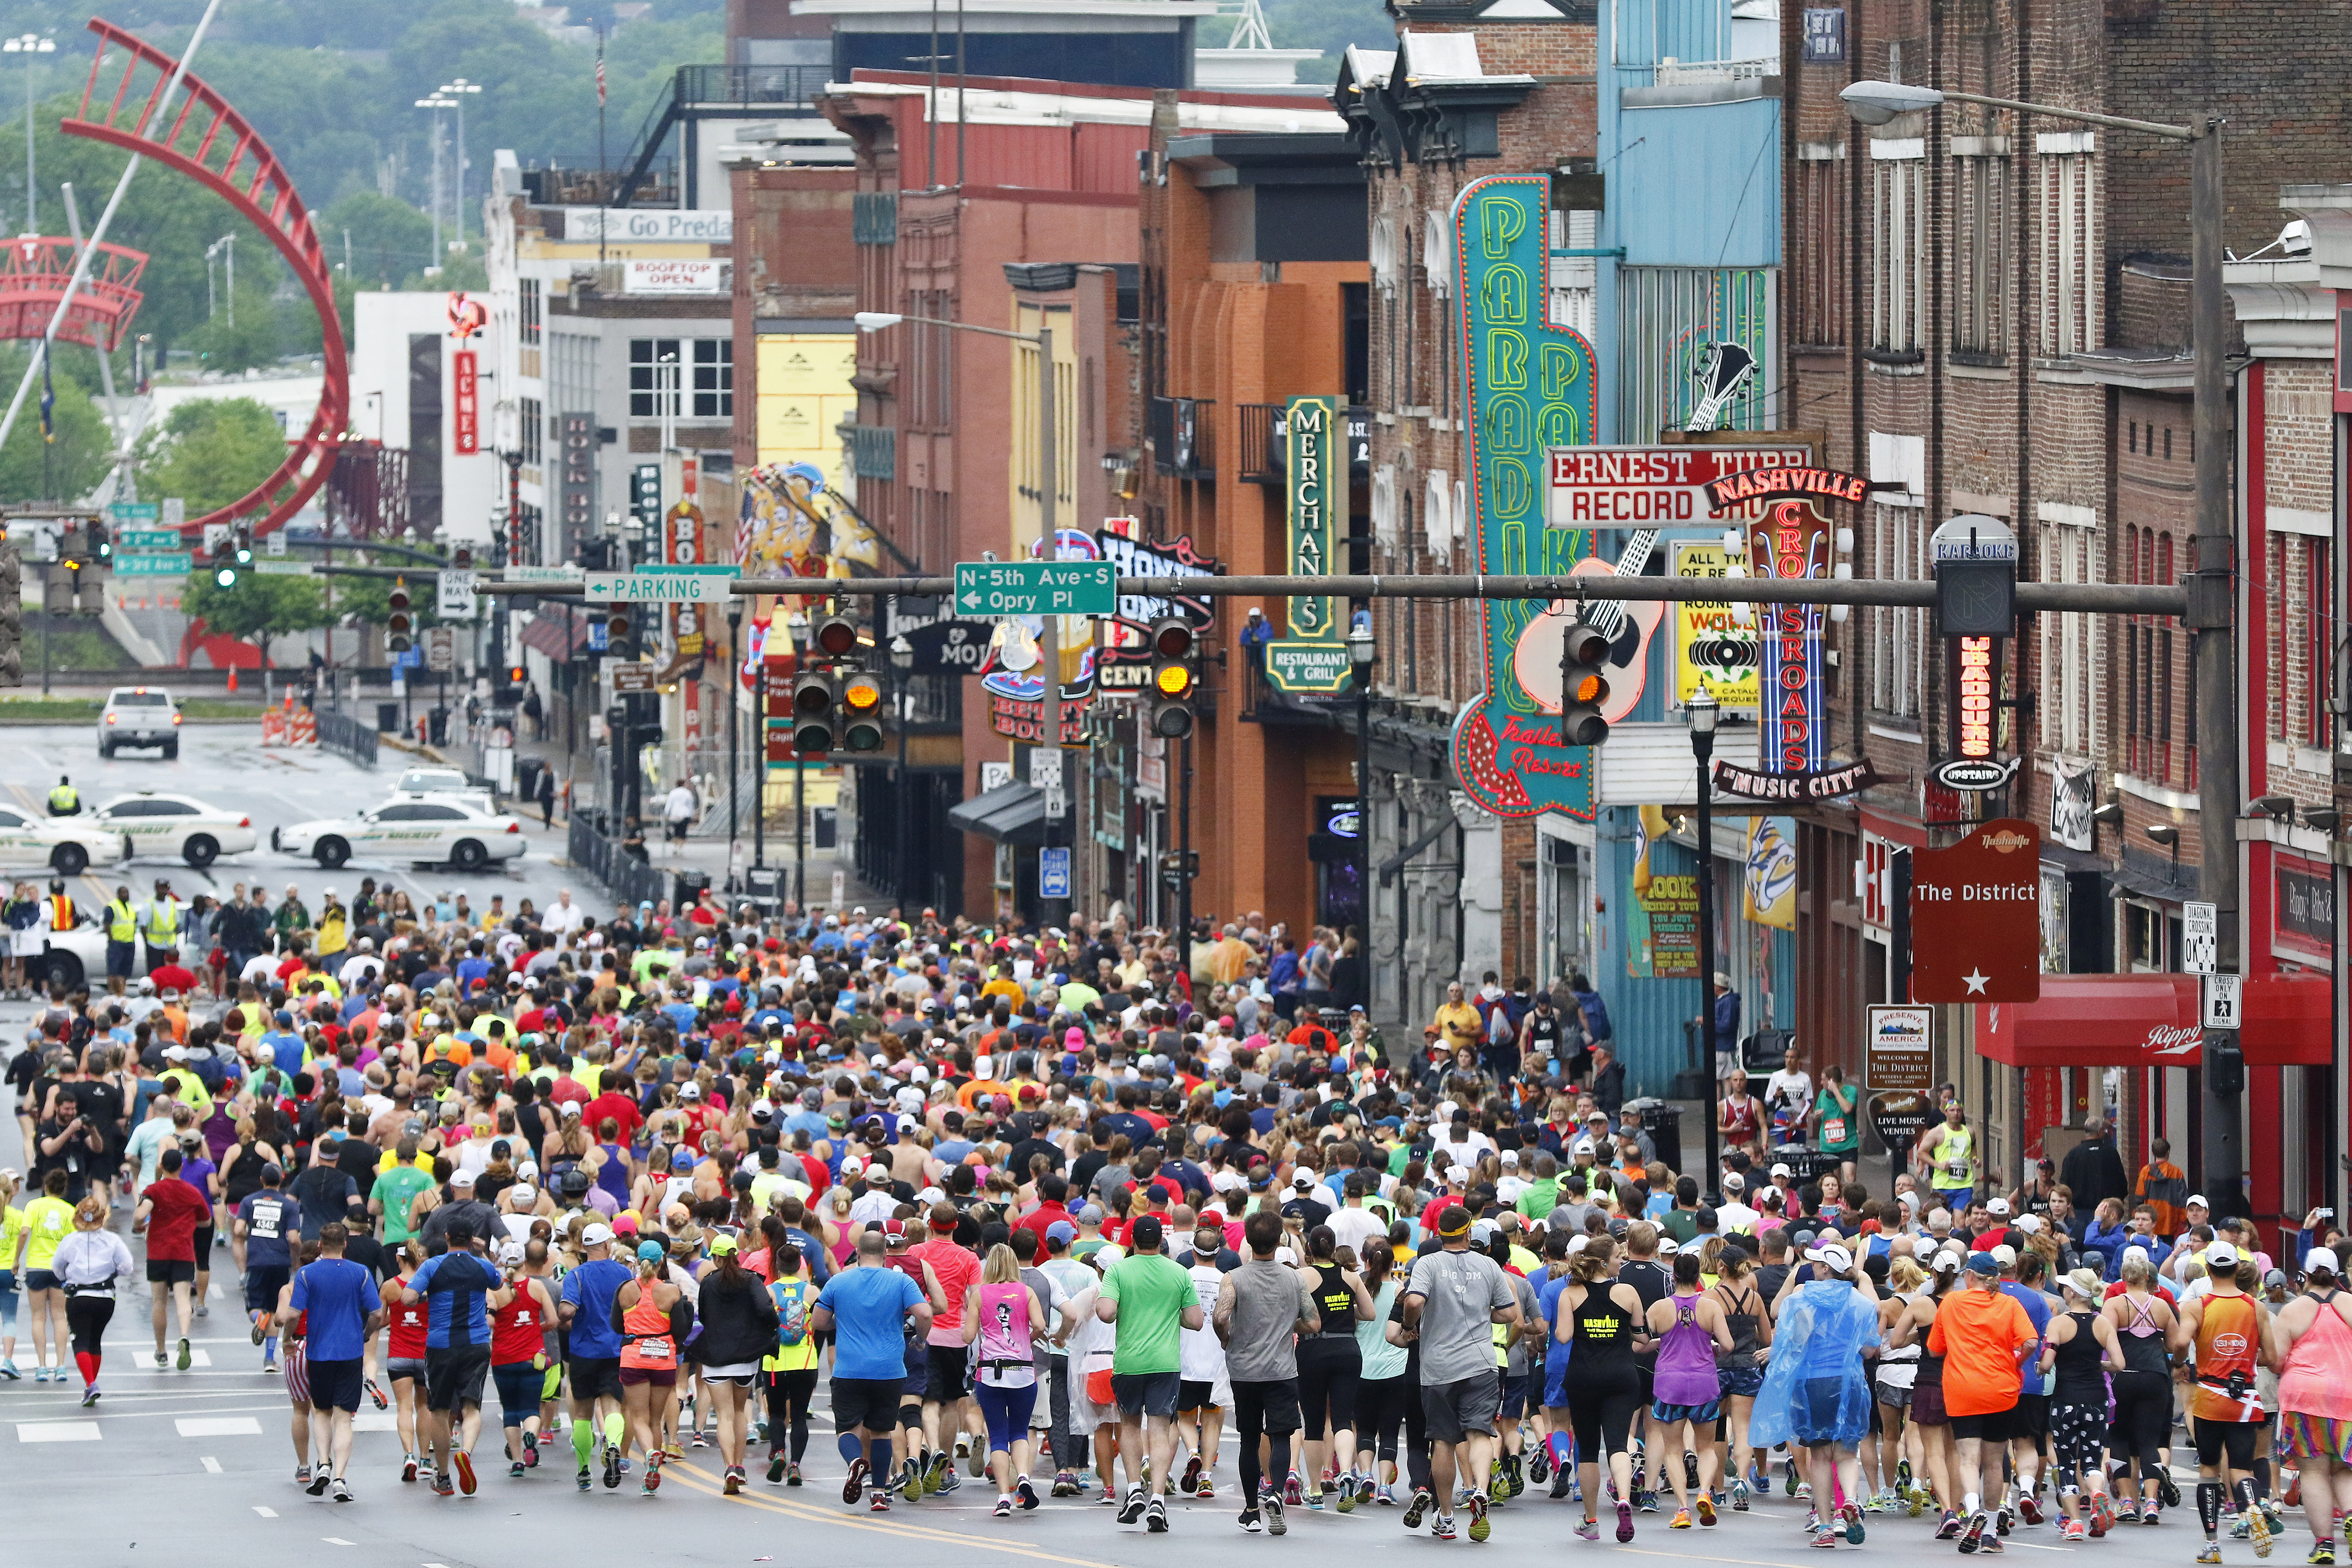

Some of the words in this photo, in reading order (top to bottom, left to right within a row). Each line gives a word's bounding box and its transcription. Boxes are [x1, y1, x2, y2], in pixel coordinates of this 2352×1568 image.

[629, 215, 658, 235] Go
[635, 263, 710, 272] ROOFTOP
[650, 274, 694, 283] OPEN
[1536, 343, 1581, 576] PAK
[1555, 452, 1691, 483] ERNEST
[1713, 468, 1866, 504] NASHVILLE
[1573, 491, 1692, 520] RECORD
[1296, 409, 1322, 628] MERCHANS
[1938, 543, 2014, 559] KARAOKE
[1689, 553, 1715, 564] ALL
[445, 573, 469, 584] ONE
[520, 569, 567, 580] PARKING
[1681, 568, 1701, 577] OF
[445, 586, 470, 597] WAY
[614, 579, 701, 598] PARKING
[989, 592, 1037, 611] Opry
[1053, 592, 1073, 608] Pl
[1776, 501, 1809, 770] CROSROADS
[1275, 652, 1347, 666] RESTAURANT
[1286, 666, 1297, 681] &
[1304, 667, 1337, 680] GRILL
[1511, 746, 1582, 778] Resort
[1982, 834, 2030, 849] Nashville
[1917, 884, 1952, 901] The
[1963, 883, 2035, 902] District
[2312, 887, 2325, 923] Ribs
[2188, 906, 2212, 920] DIAGONAL
[2189, 920, 2213, 934] CROSSING
[2186, 938, 2198, 963] OK
[1878, 1011, 1924, 1025] PRESERVE
[1891, 1063, 1929, 1072] DISTRICT
[1899, 1116, 1925, 1125] MUSIC
[256, 1219, 275, 1230] 6345
[1442, 1269, 1458, 1279] BIG
[1324, 1292, 1350, 1303] NASHVILLE
[1583, 1316, 1619, 1328] NASHVILLE
